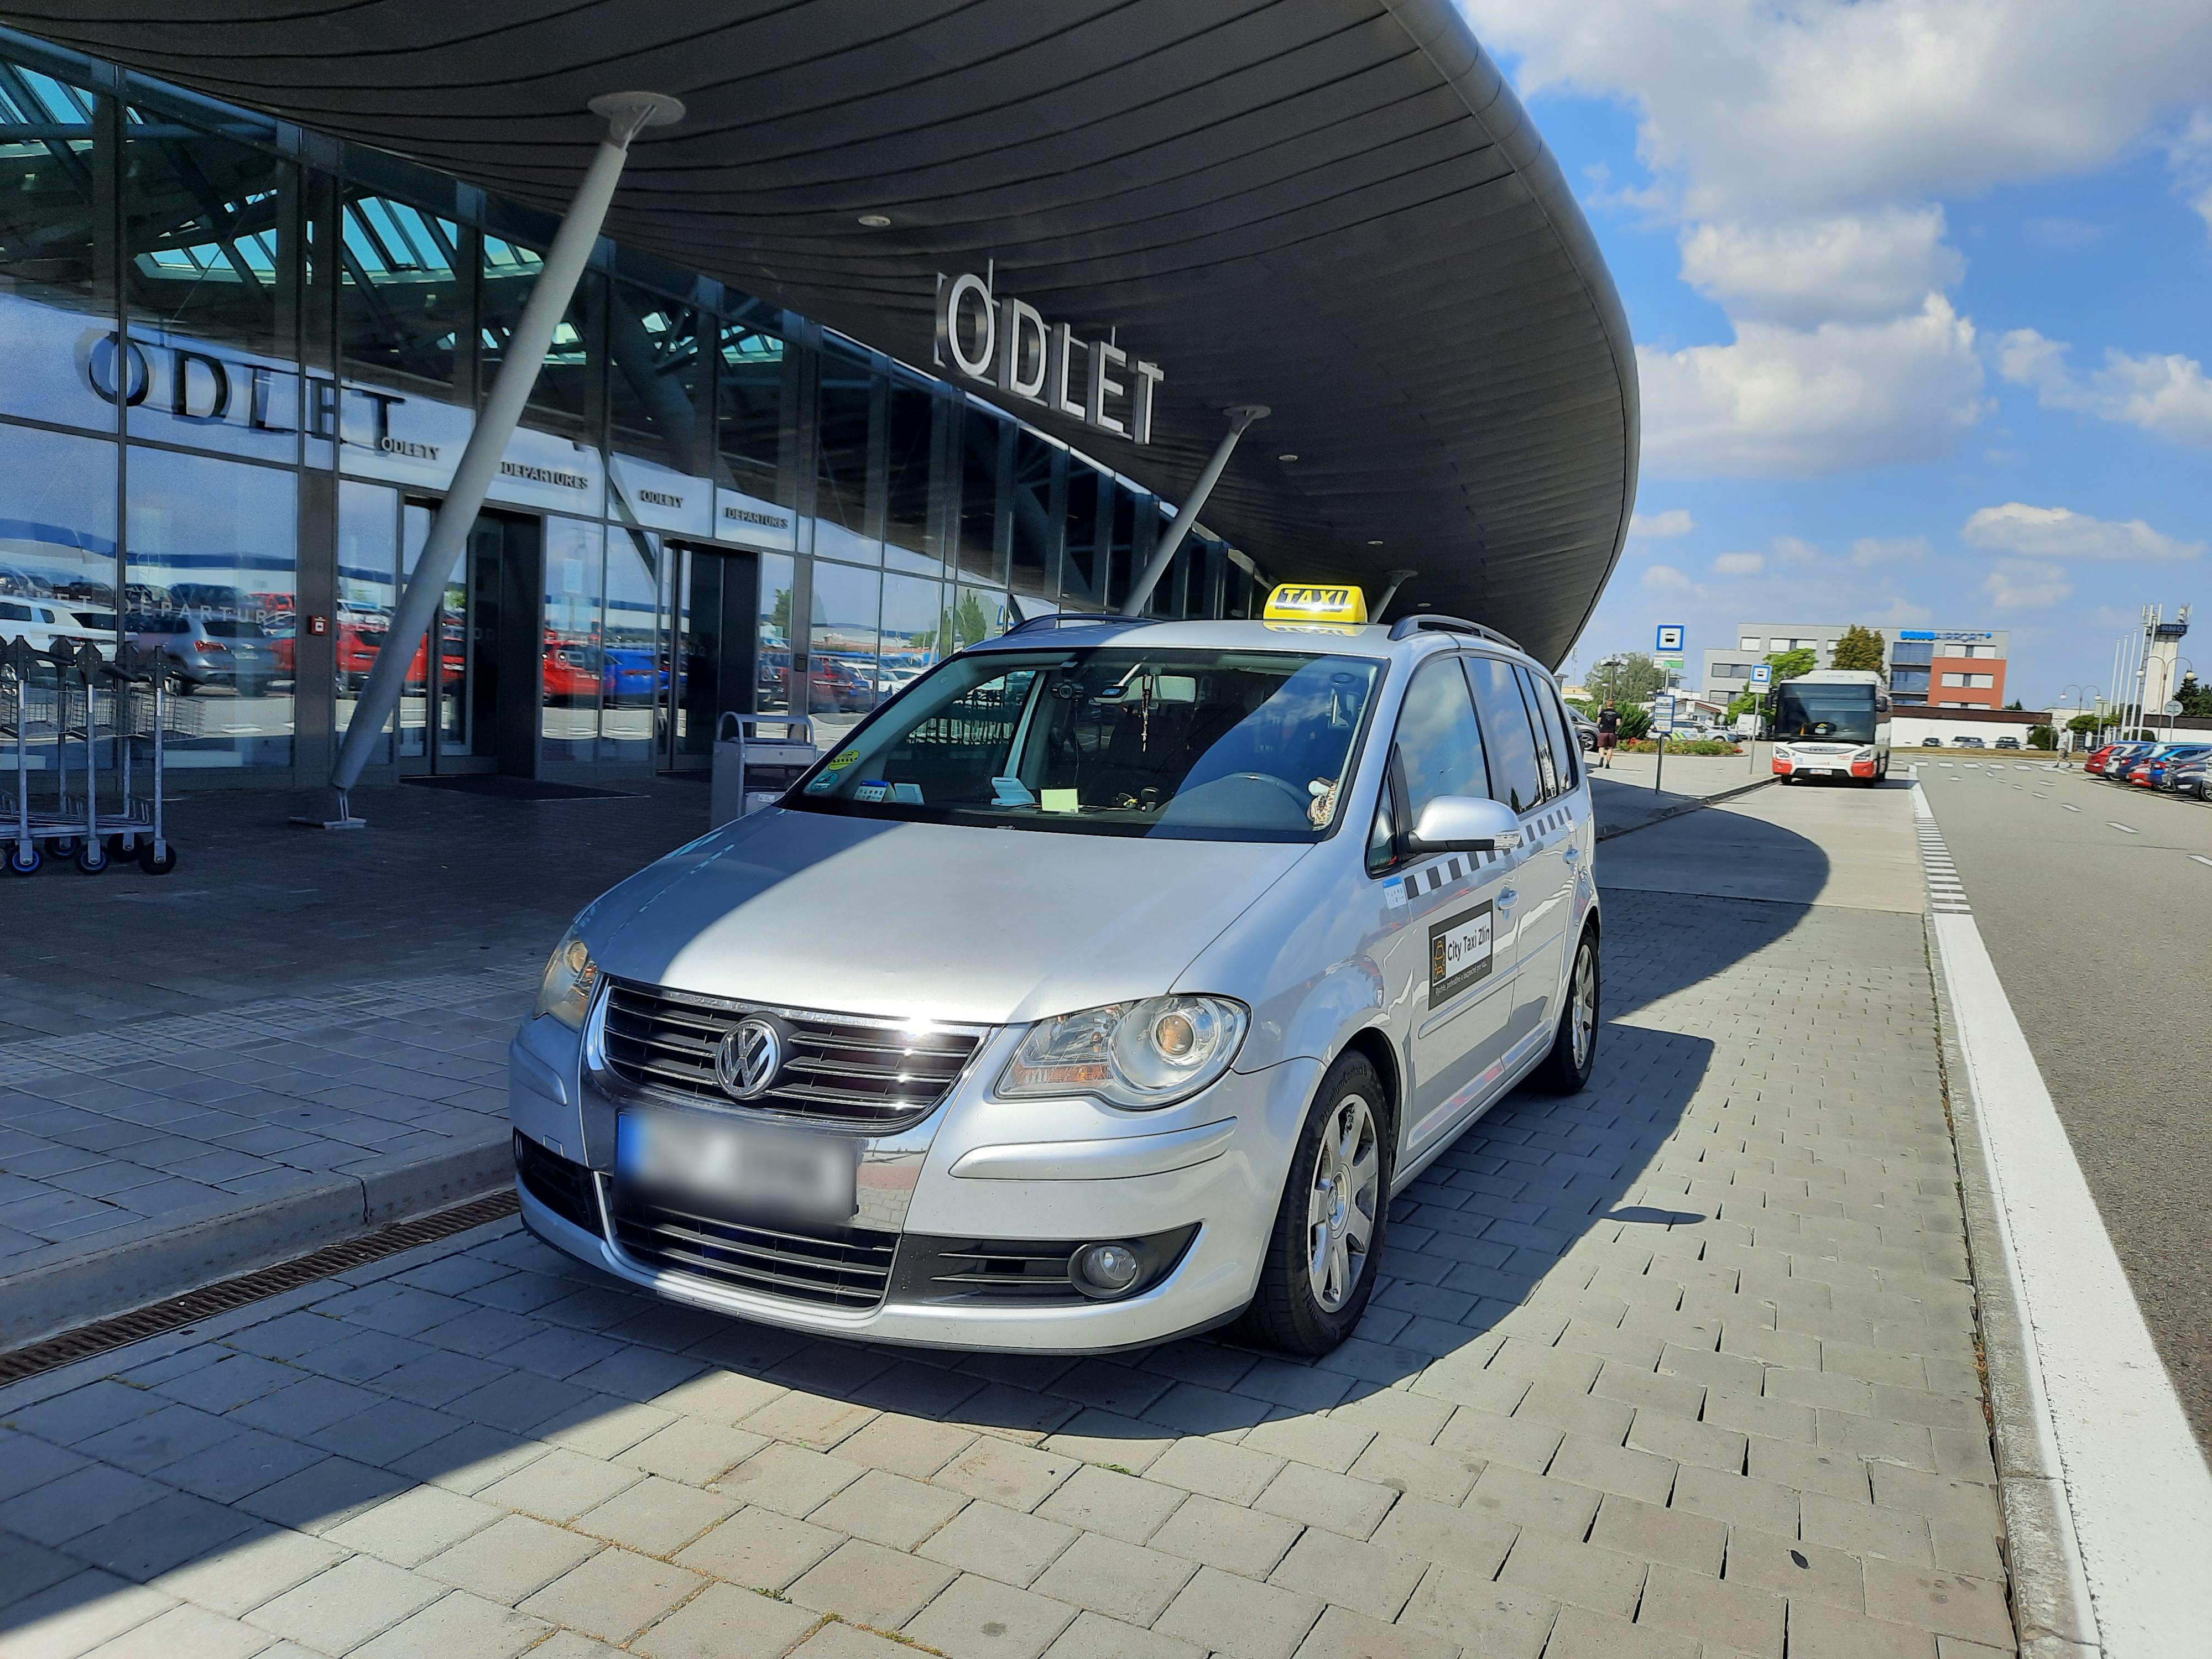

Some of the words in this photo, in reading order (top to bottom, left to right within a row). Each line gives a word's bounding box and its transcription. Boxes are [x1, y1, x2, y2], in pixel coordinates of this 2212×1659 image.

[943, 273, 1165, 445] ODLET
[381, 436, 441, 461] ODLETY
[502, 461, 588, 490] DEPARTURES
[727, 507, 788, 530] DEPARTURES
[1283, 589, 1345, 607] TAXI
[1447, 940, 1462, 962] City
[1463, 929, 1477, 953] Taxi
